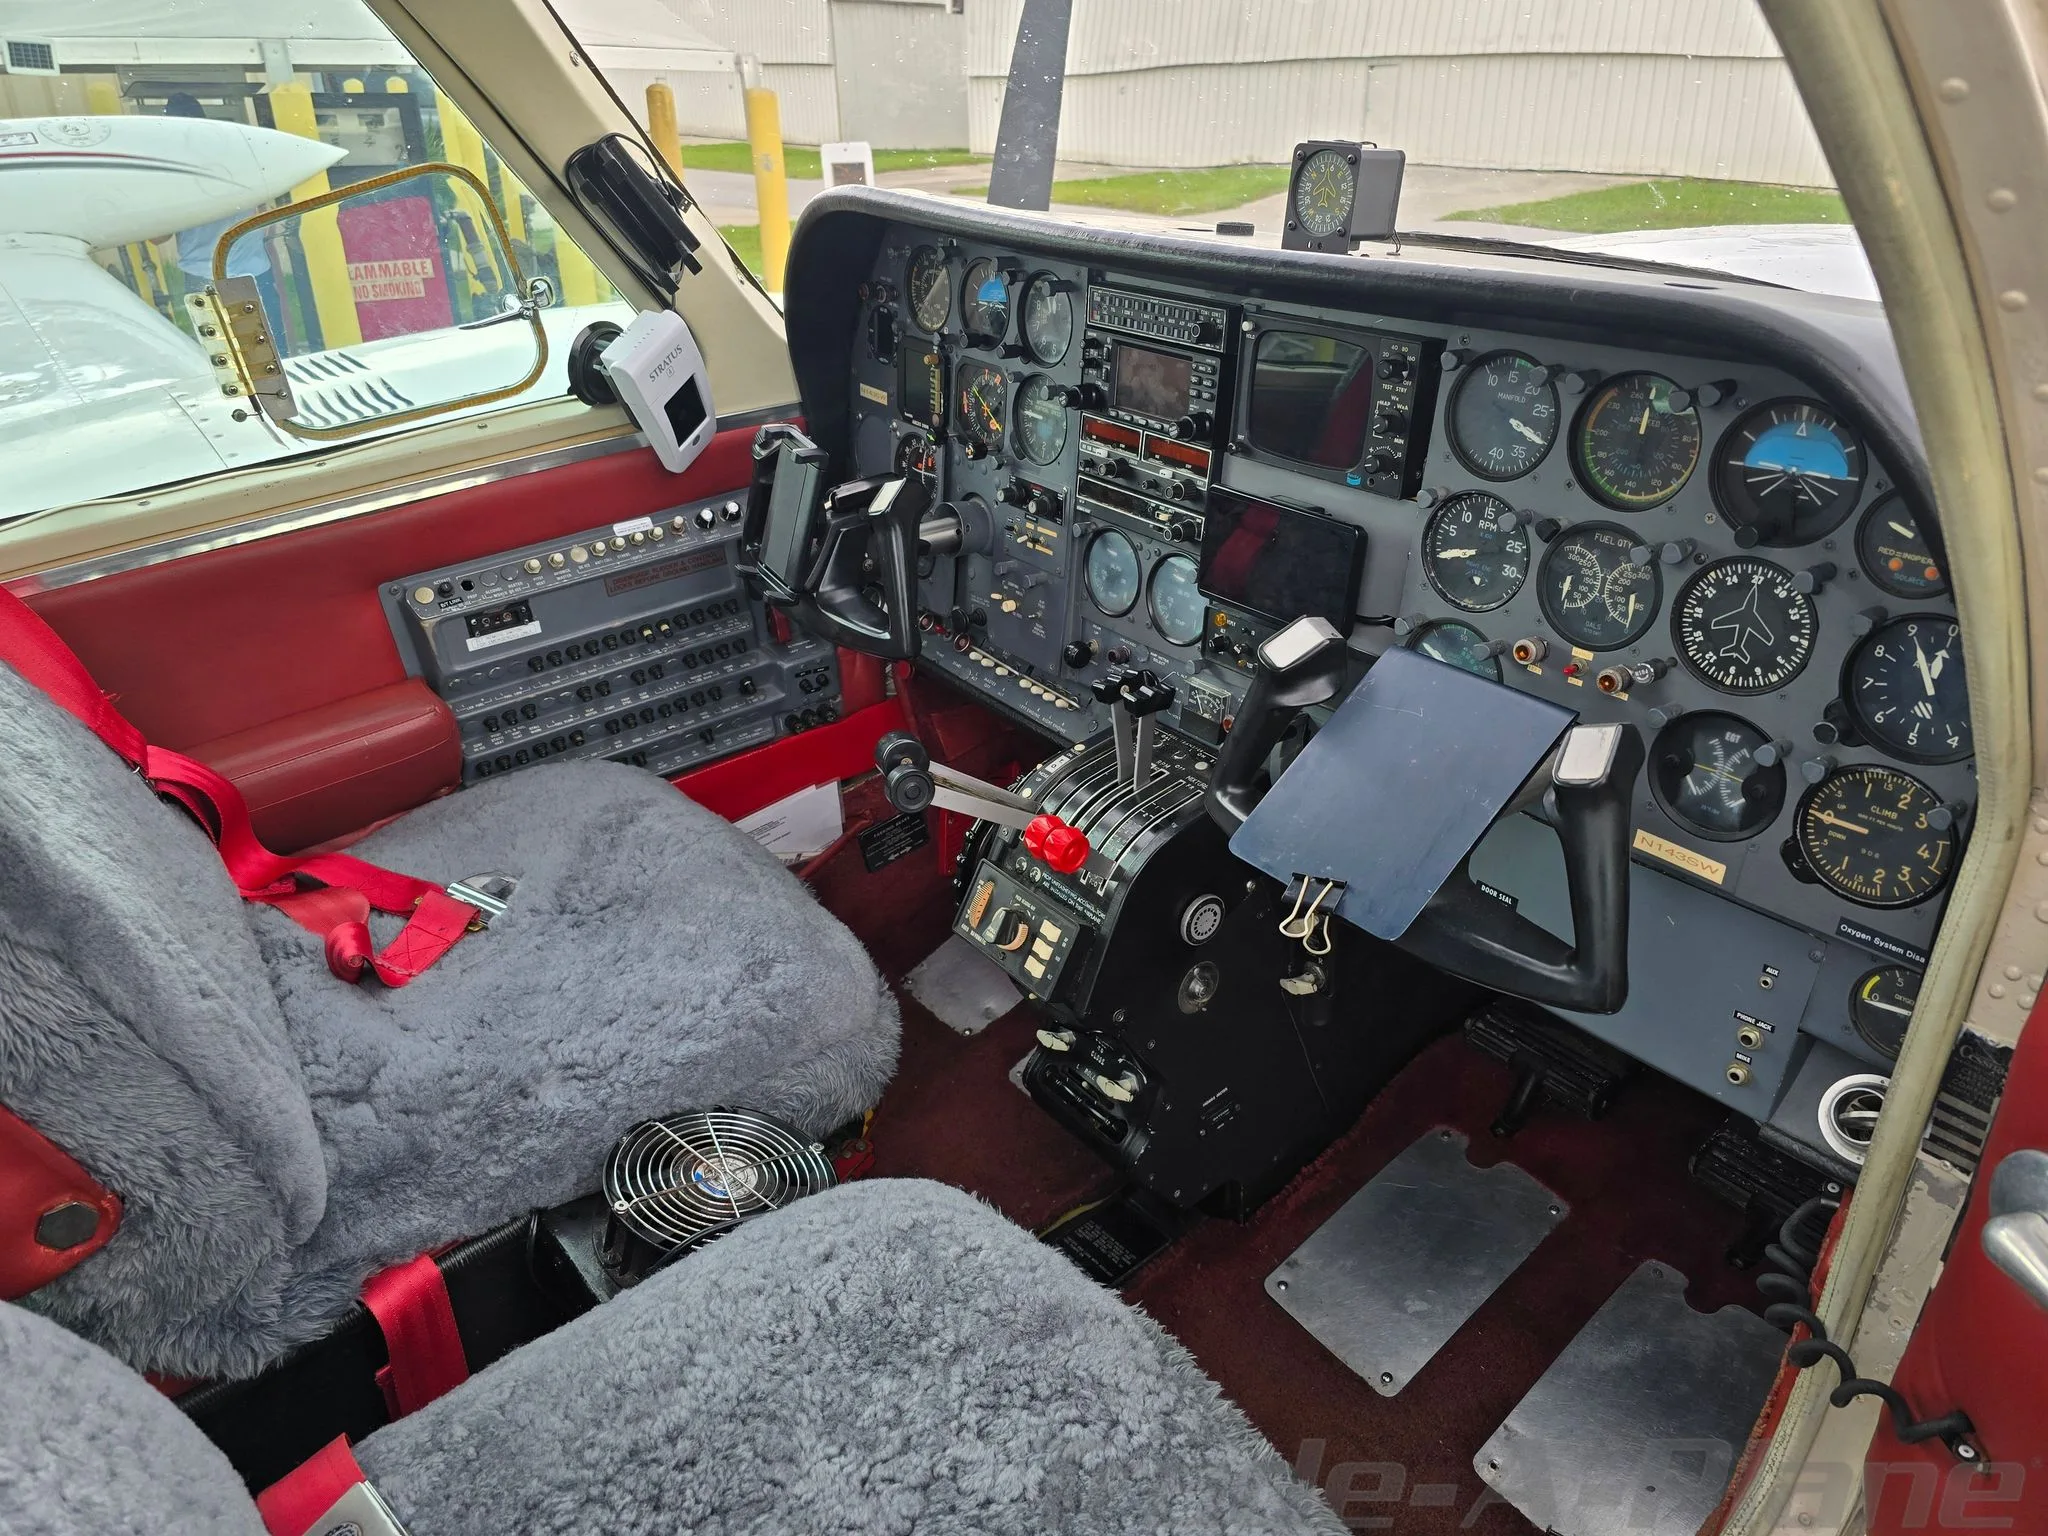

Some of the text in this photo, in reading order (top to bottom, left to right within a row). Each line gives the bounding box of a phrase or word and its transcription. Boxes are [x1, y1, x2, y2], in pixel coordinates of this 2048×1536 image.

[649, 344, 683, 383] STRATUS
[1487, 374, 1499, 386] 10
[1507, 370, 1519, 384] 15
[1382, 383, 1407, 394] TEST STBY
[1524, 382, 1541, 396] 20
[1497, 392, 1526, 404] MANIFOLD
[1532, 403, 1549, 417] 25
[1394, 437, 1404, 445] MIN
[1488, 447, 1505, 460] 40
[1510, 444, 1527, 459] 35
[1624, 480, 1637, 488] 140
[1461, 510, 1473, 524] 10
[1484, 506, 1496, 520] 15
[1448, 525, 1458, 537] 5
[1478, 519, 1498, 533] RPM
[1505, 540, 1523, 554] 25
[1594, 532, 1634, 550] FUEL QTY
[1567, 552, 1580, 562] 300
[1578, 558, 1592, 568] 250
[1501, 564, 1518, 578] 30
[1580, 567, 1594, 576] 200
[1622, 570, 1637, 580] 250
[1636, 572, 1650, 581] 300
[1583, 576, 1594, 585] 150
[1617, 578, 1631, 586] 200
[1725, 574, 1739, 586] 24
[1578, 584, 1589, 593] 100
[1704, 586, 1717, 599] 21
[1773, 585, 1789, 599] 30
[1572, 591, 1582, 600] 50
[1614, 595, 1626, 604] 100
[1617, 604, 1626, 612] 50
[1693, 607, 1704, 619] 18
[1788, 607, 1800, 621] 33
[1693, 630, 1705, 643] 15
[1907, 623, 1919, 637] 9
[1948, 624, 1959, 637] 0
[1789, 635, 1800, 643] 0
[1704, 651, 1718, 664] 12
[1874, 644, 1885, 658] 8
[1776, 655, 1786, 664] 3
[1862, 676, 1875, 690] 7
[1874, 711, 1885, 724] 6
[1724, 731, 1742, 744] EGT
[1907, 732, 1918, 746] 5
[1946, 735, 1960, 749] 4
[1185, 775, 1209, 790] MIXTURE
[1836, 803, 1847, 811] UP
[1897, 793, 1912, 810] 2
[1870, 804, 1898, 820] CLIMB
[1914, 812, 1928, 830] 3
[1827, 830, 1847, 841] DOWN
[1640, 836, 1719, 876] N143SW
[1916, 843, 1931, 860] 4
[1872, 868, 1886, 885] 2
[1897, 865, 1912, 882] 3
[1481, 884, 1513, 905] DOOR SEAL
[1067, 898, 1075, 906] ON
[1840, 923, 1926, 964] Oxygen System Disa
[1765, 966, 1779, 977] AUX
[1871, 993, 1880, 1002] 0
[1736, 1012, 1772, 1031] PHONE JACK
[1736, 1052, 1751, 1063] MIKE
